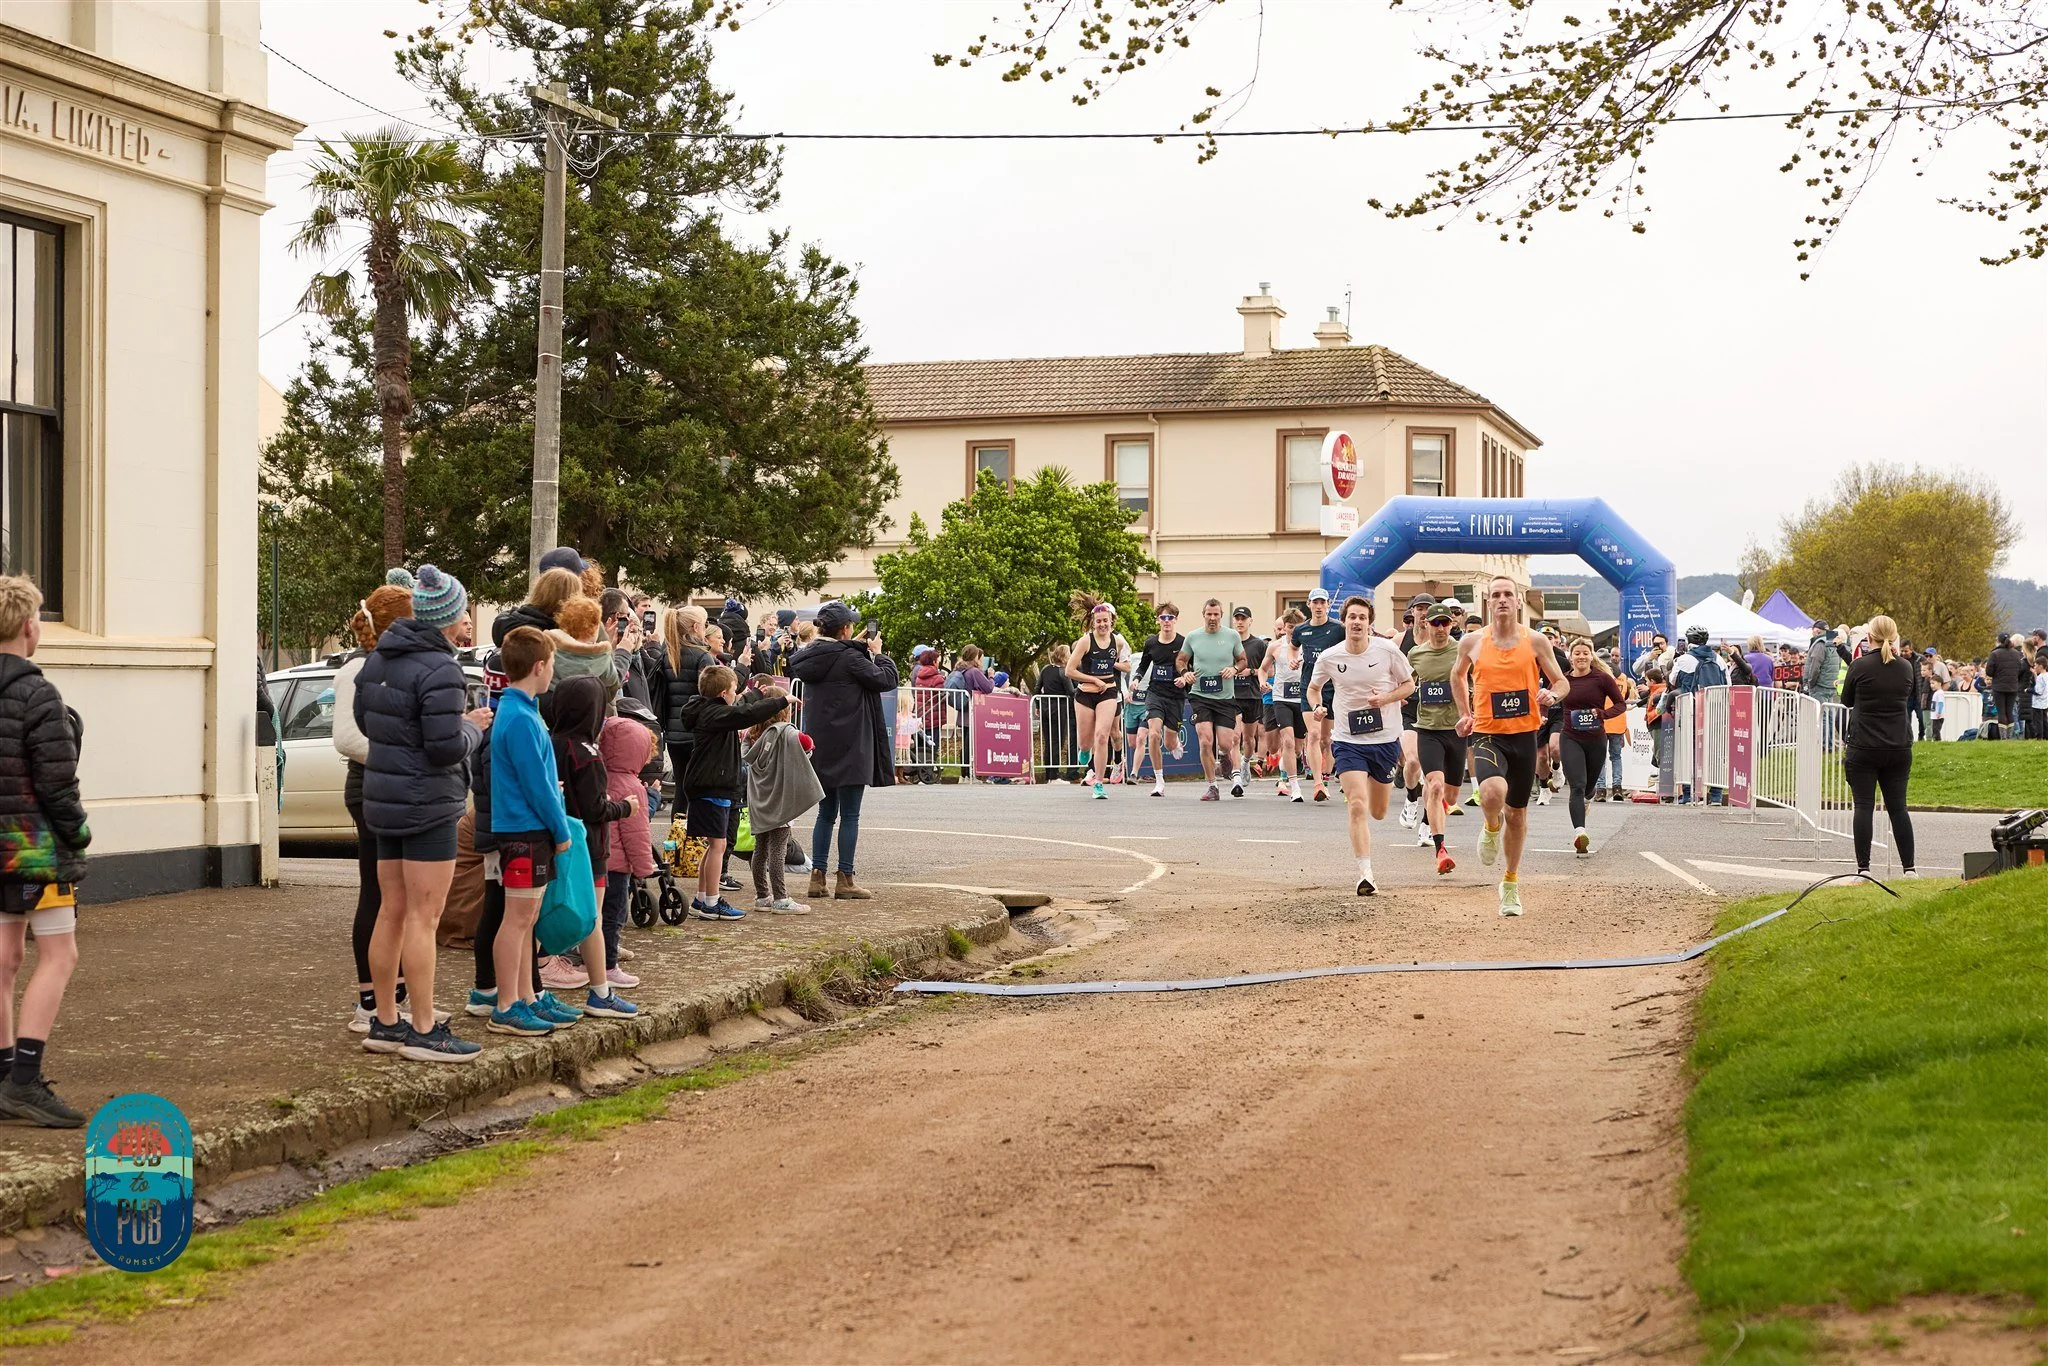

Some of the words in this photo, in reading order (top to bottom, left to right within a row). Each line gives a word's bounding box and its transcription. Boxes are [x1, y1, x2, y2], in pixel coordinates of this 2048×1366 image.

[0, 85, 40, 133] IA.
[52, 101, 150, 164] LIMITED
[1470, 514, 1513, 536] FINISH
[1635, 630, 1653, 648] PUB
[1427, 687, 1443, 696] 820
[1501, 698, 1520, 708] 449
[1356, 715, 1374, 725] 719
[1578, 714, 1593, 722] 382
[1633, 728, 1652, 741] Macedo
[1633, 741, 1650, 756] Ranges
[993, 751, 1008, 765] Bendigo
[1009, 752, 1019, 763] Bank
